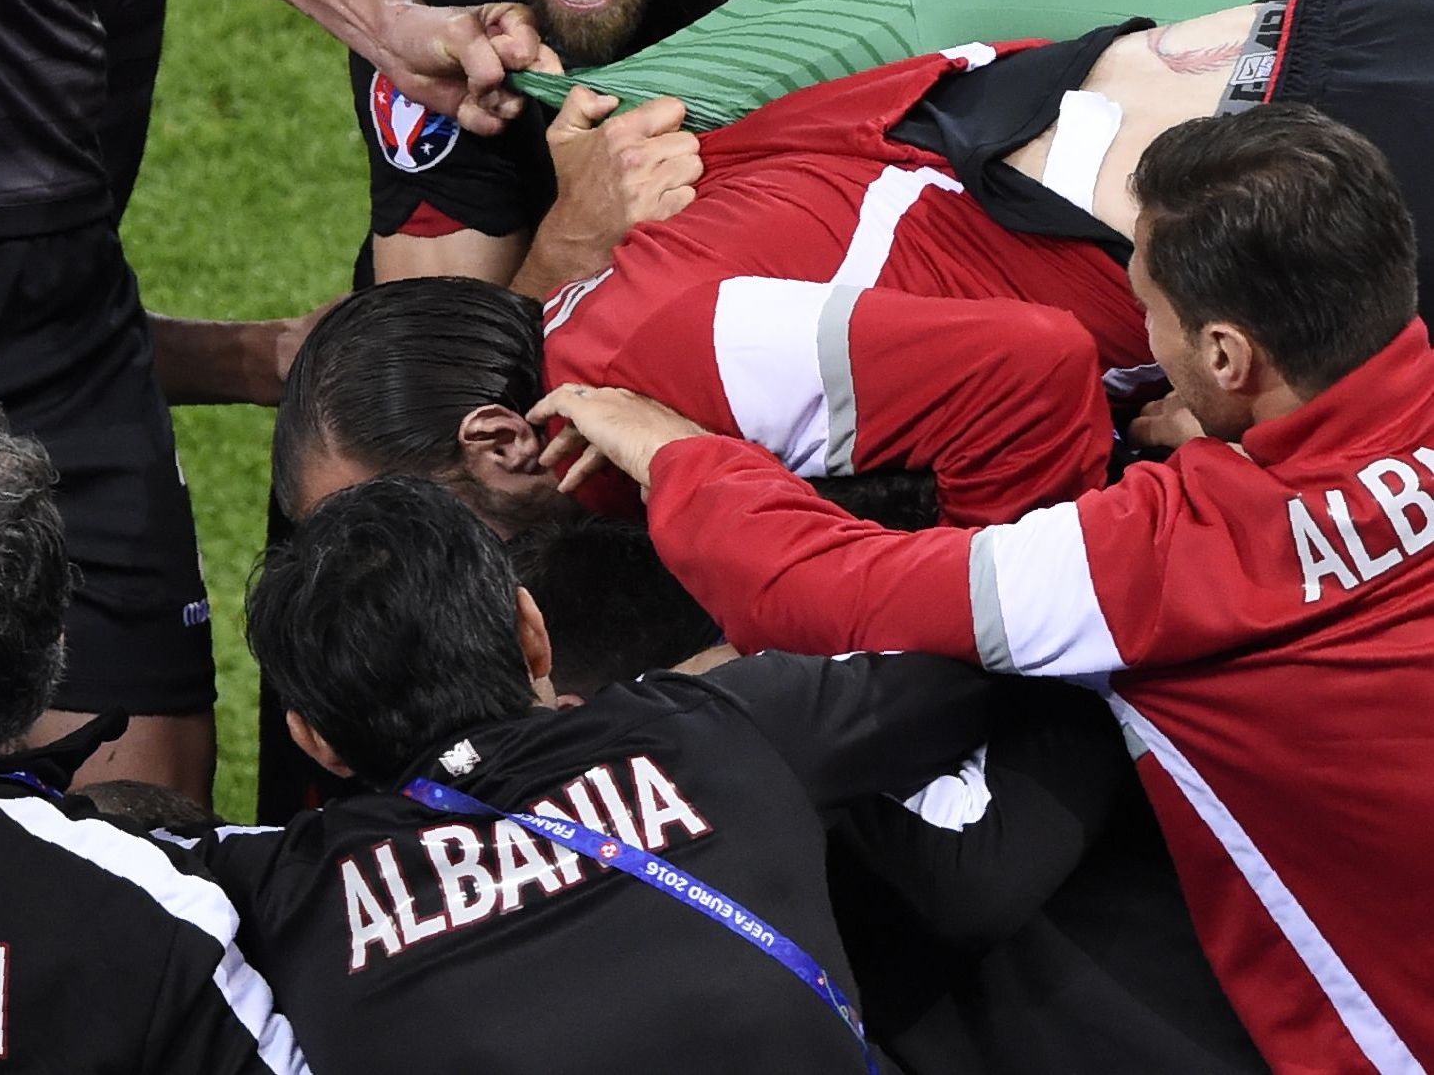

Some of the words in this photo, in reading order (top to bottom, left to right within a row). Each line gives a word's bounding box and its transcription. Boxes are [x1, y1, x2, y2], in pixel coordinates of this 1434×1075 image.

[1287, 445, 1434, 603] ALB
[645, 861, 689, 893] 2016
[687, 885, 734, 919] EURO
[734, 910, 775, 948] UEFA
